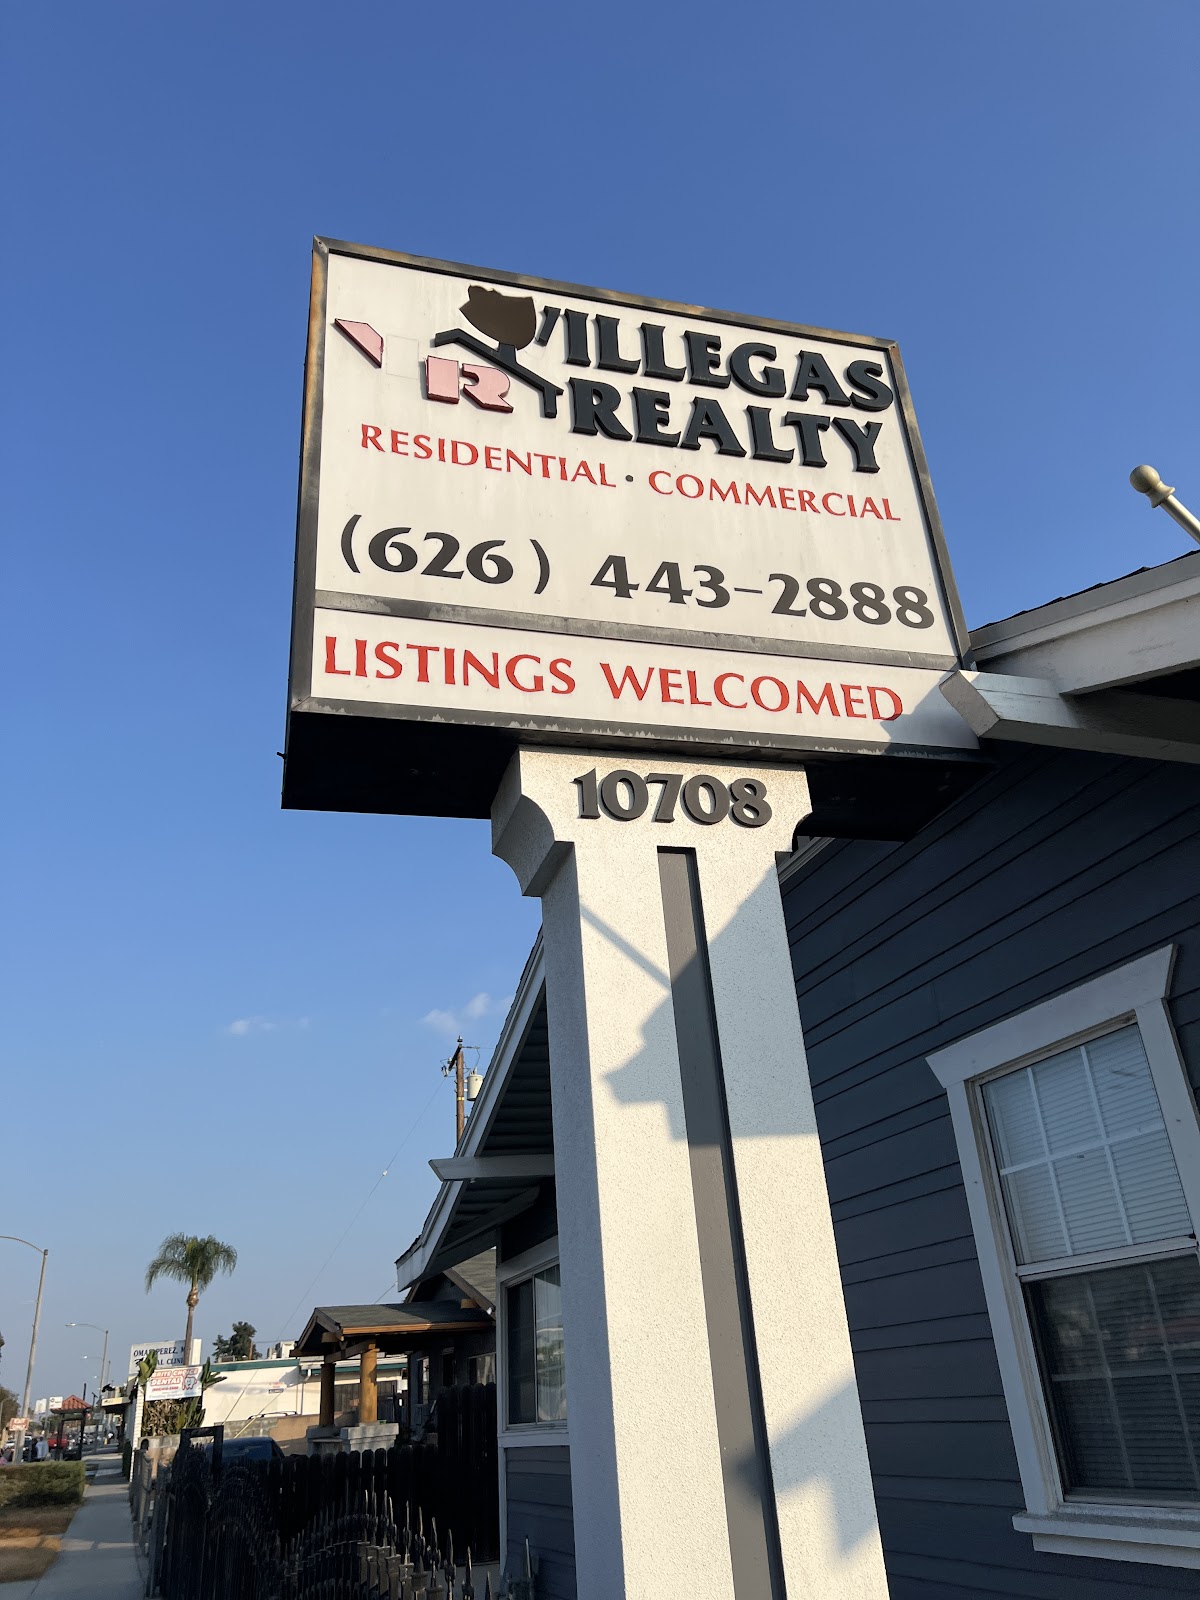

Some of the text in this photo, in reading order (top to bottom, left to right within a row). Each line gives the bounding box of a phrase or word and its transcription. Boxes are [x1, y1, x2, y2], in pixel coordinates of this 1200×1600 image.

[567, 376, 883, 474] REALTY
[361, 423, 902, 521] RESIDENTIAL COMMERCIAL
[340, 514, 933, 629] (626) 443-2888
[324, 635, 904, 721] LISTINGS WELCOMED
[570, 767, 772, 829] 10708
[133, 1348, 151, 1357] OMA
[150, 1376, 182, 1386] DENTAL
[166, 1357, 184, 1365] CLINI
